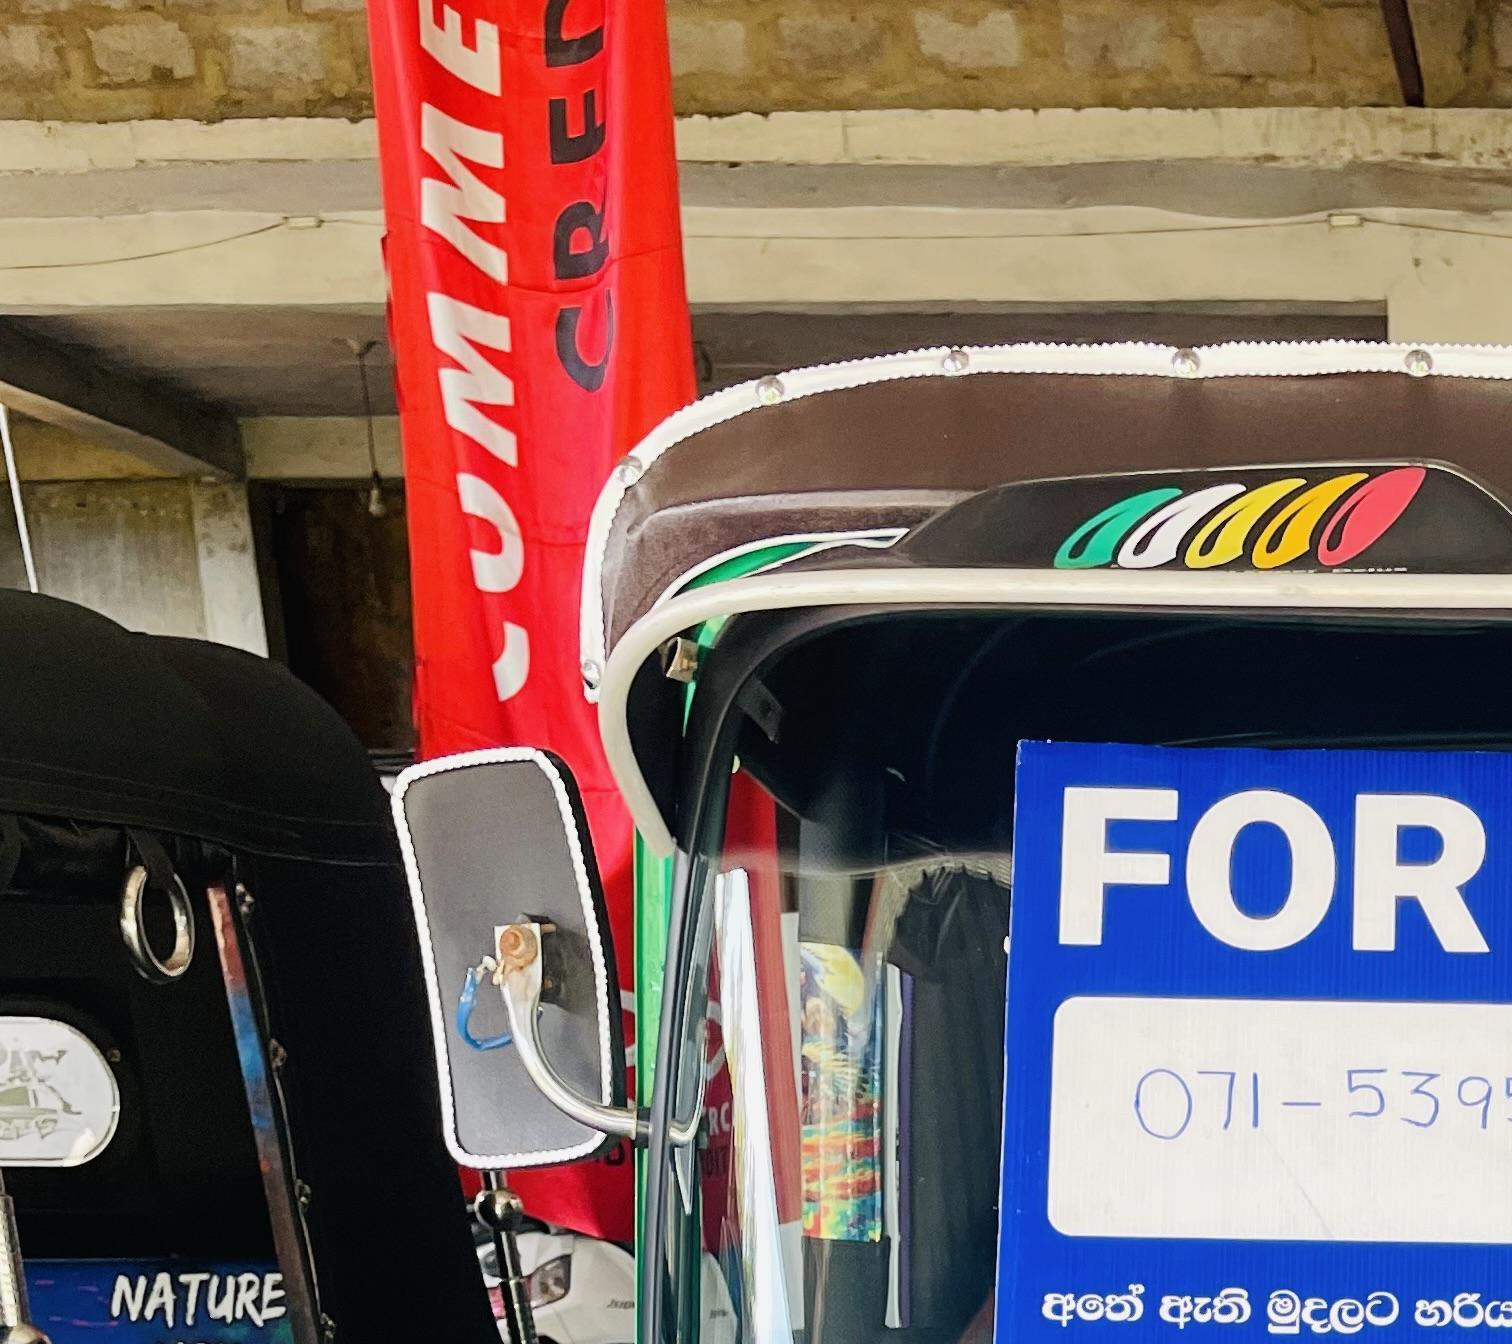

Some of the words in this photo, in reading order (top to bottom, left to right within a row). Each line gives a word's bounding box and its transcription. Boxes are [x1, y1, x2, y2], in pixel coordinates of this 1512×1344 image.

[1057, 785, 1491, 955] FOR
[110, 1271, 288, 1327] NATURE
[1040, 1283, 1145, 1329] අතේ
[1158, 1286, 1252, 1330] ඇති
[1266, 1289, 1401, 1335] මුදලට
